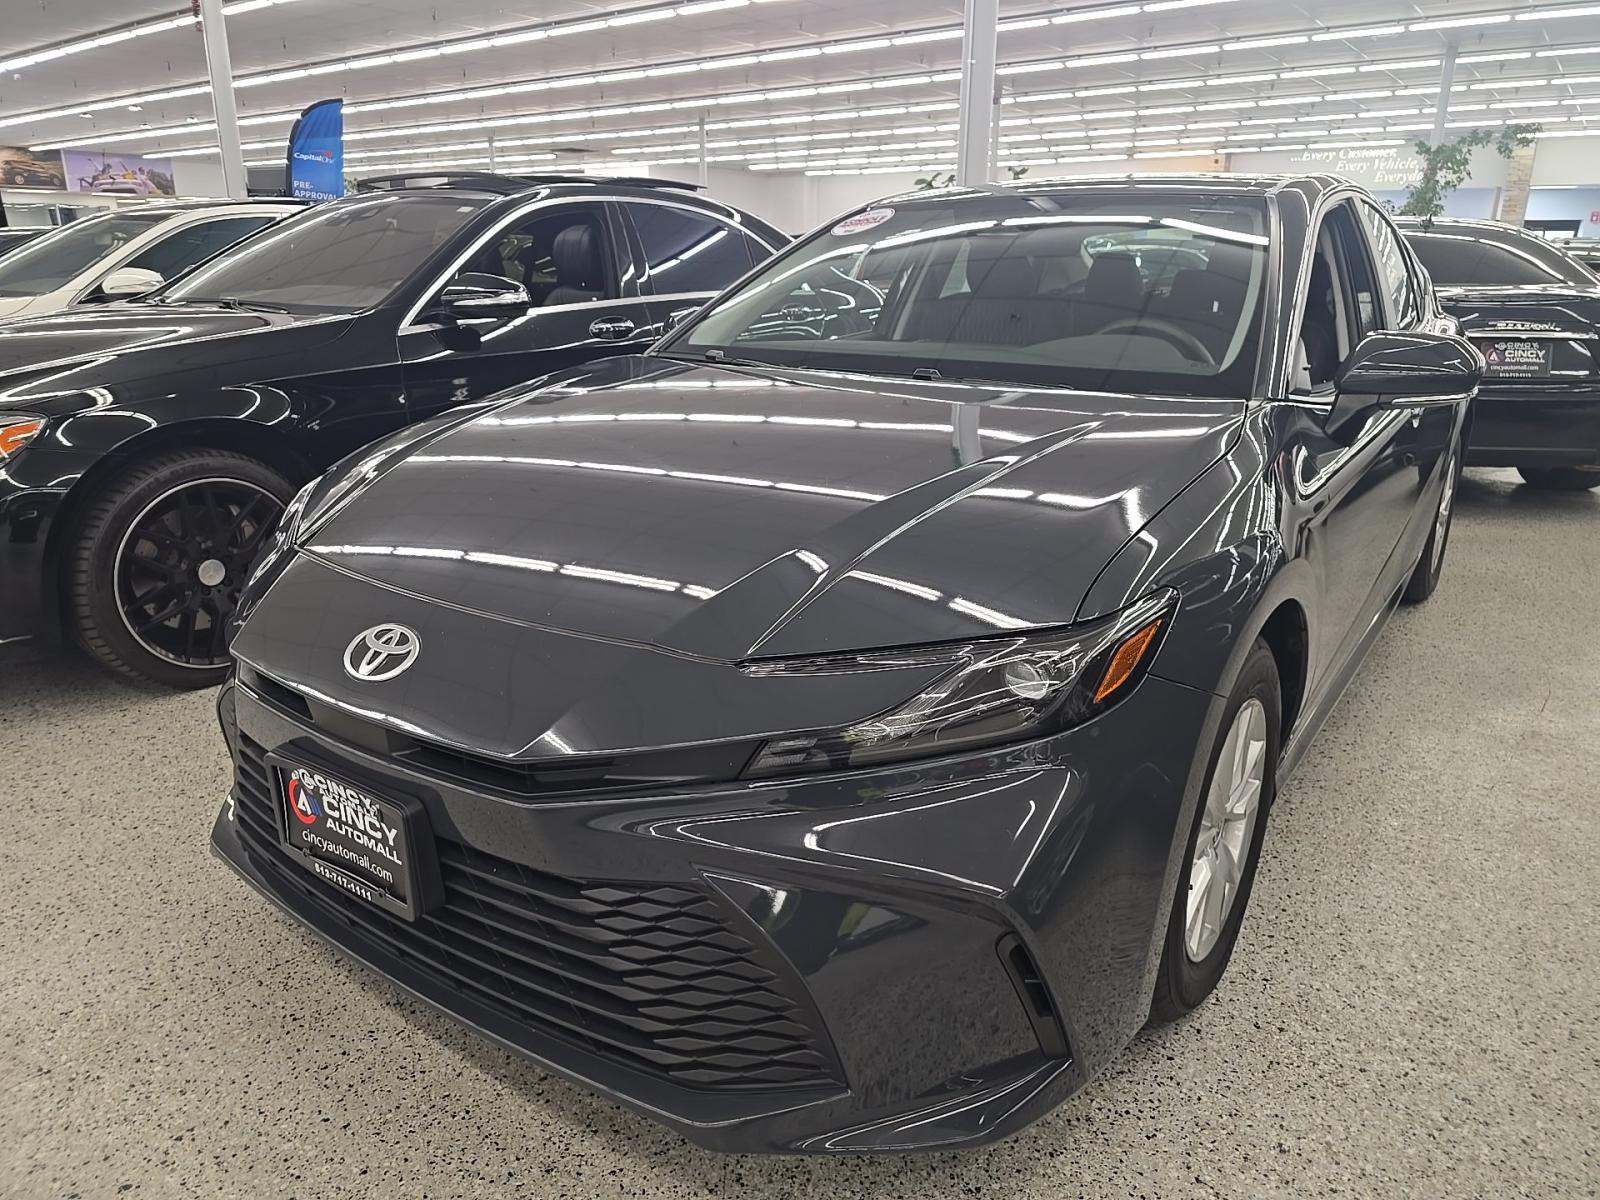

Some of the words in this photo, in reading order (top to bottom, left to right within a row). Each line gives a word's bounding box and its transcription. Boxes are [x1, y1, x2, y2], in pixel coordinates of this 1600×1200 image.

[1336, 160, 1370, 172] Every
[1374, 170, 1425, 185] Everyda
[1504, 350, 1546, 358] CINCY
[322, 796, 398, 847] CINCY
[302, 828, 393, 884] cincyautomall.com
[326, 818, 402, 866] AUTOMALL
